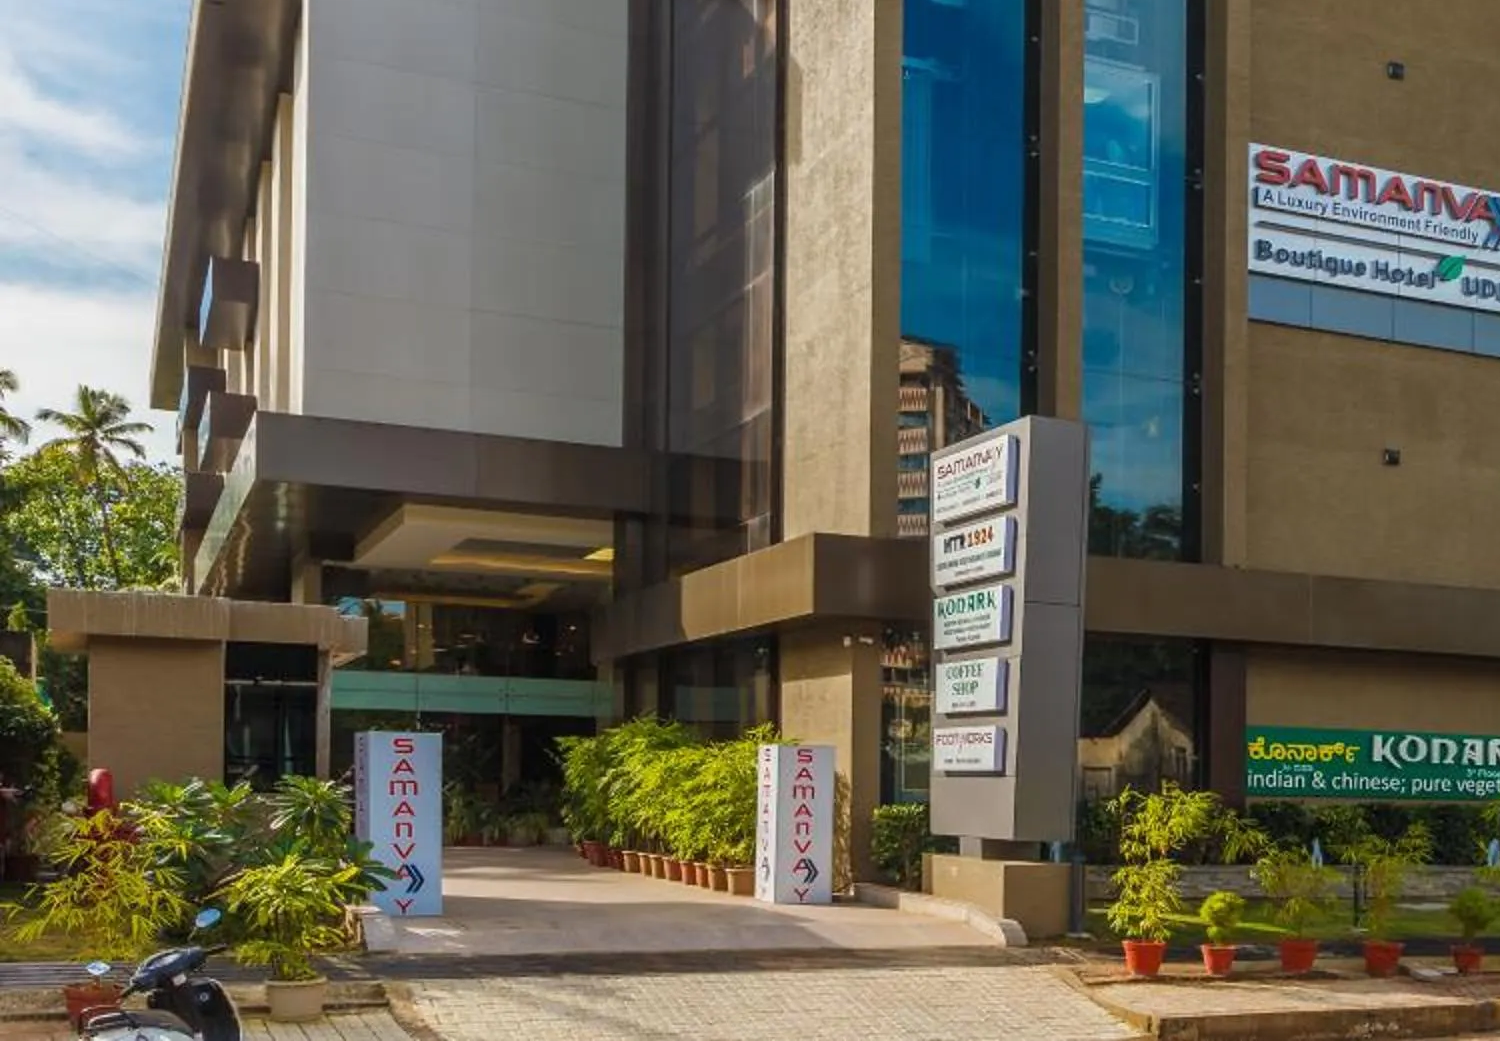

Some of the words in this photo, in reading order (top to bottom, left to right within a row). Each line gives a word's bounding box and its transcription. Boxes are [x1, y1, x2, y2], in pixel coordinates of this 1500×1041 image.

[1263, 188, 1274, 203] A
[1277, 191, 1329, 216] Luxury
[1332, 200, 1421, 232] Environment
[1424, 219, 1479, 244] Friendly
[1254, 239, 1367, 278] Boutique
[1371, 258, 1440, 290] Hotel
[945, 662, 985, 681] COFFEE
[951, 680, 979, 696] SHOP
[1247, 769, 1305, 788] indian
[1312, 771, 1327, 789] &
[1411, 776, 1452, 795] pure
